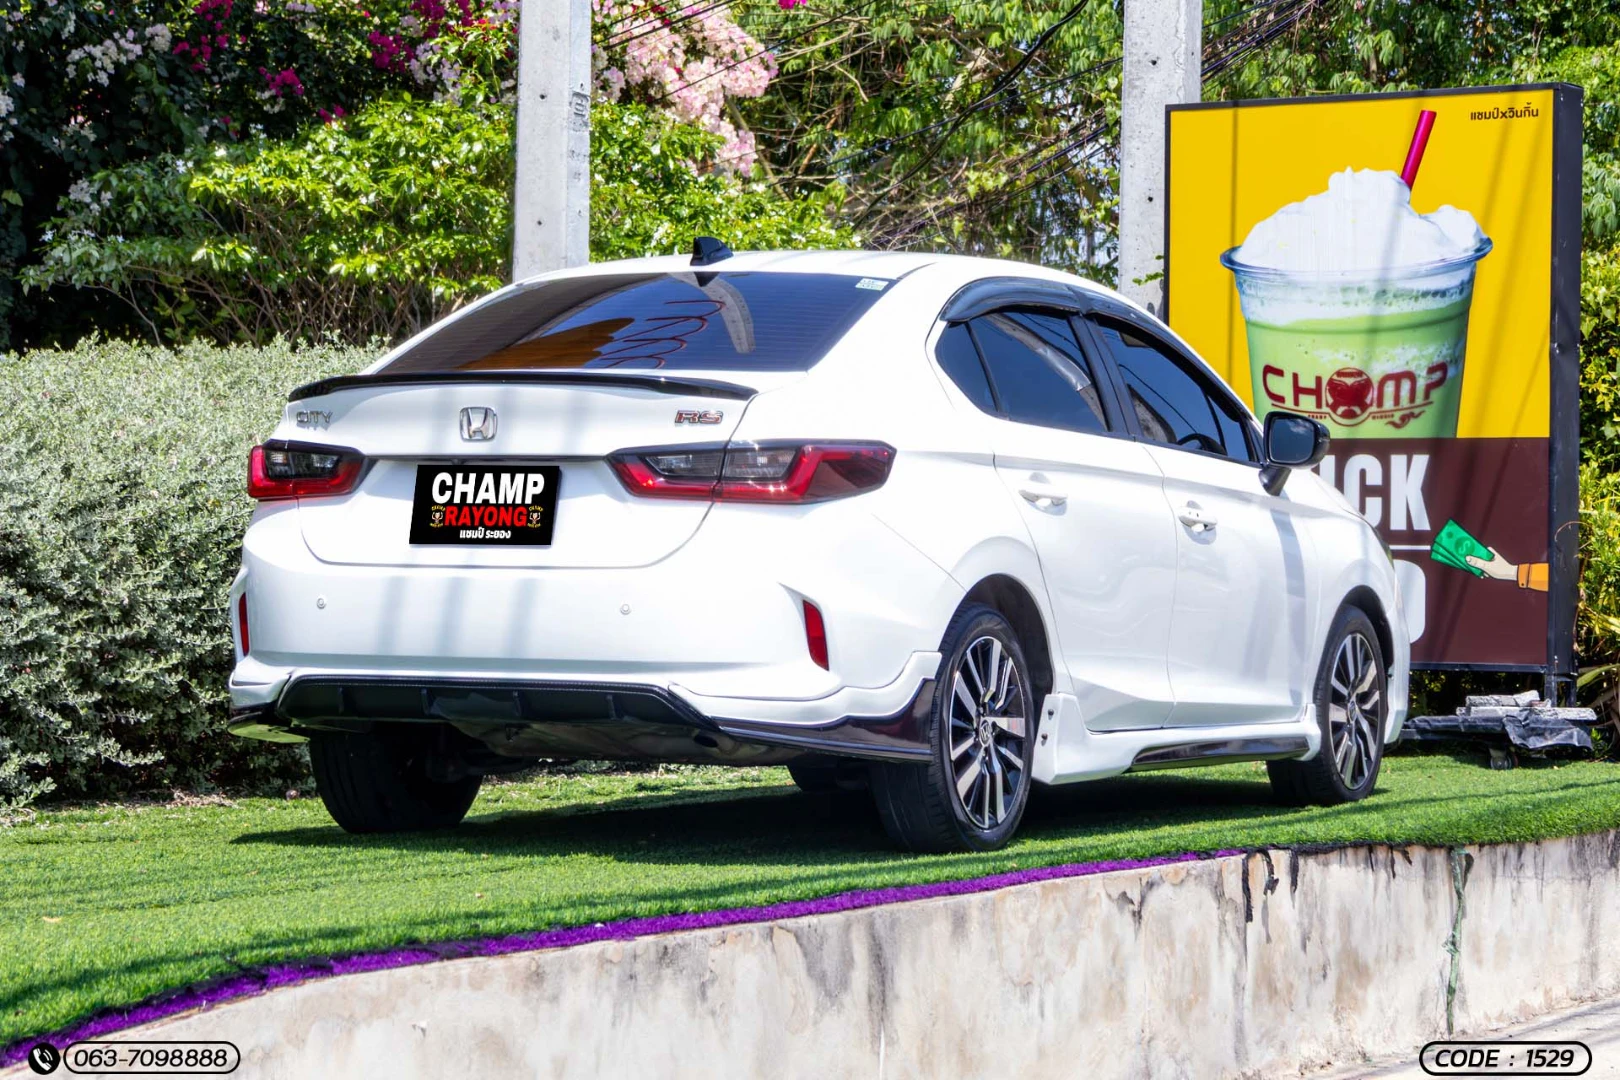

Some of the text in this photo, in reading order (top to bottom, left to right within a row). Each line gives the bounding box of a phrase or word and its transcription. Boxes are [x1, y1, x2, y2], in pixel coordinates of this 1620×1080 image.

[296, 410, 333, 424] CITY
[674, 409, 724, 425] RS
[431, 471, 545, 504] CHAMP
[444, 505, 528, 527] RAYONG
[485, 529, 512, 539] ระยอง
